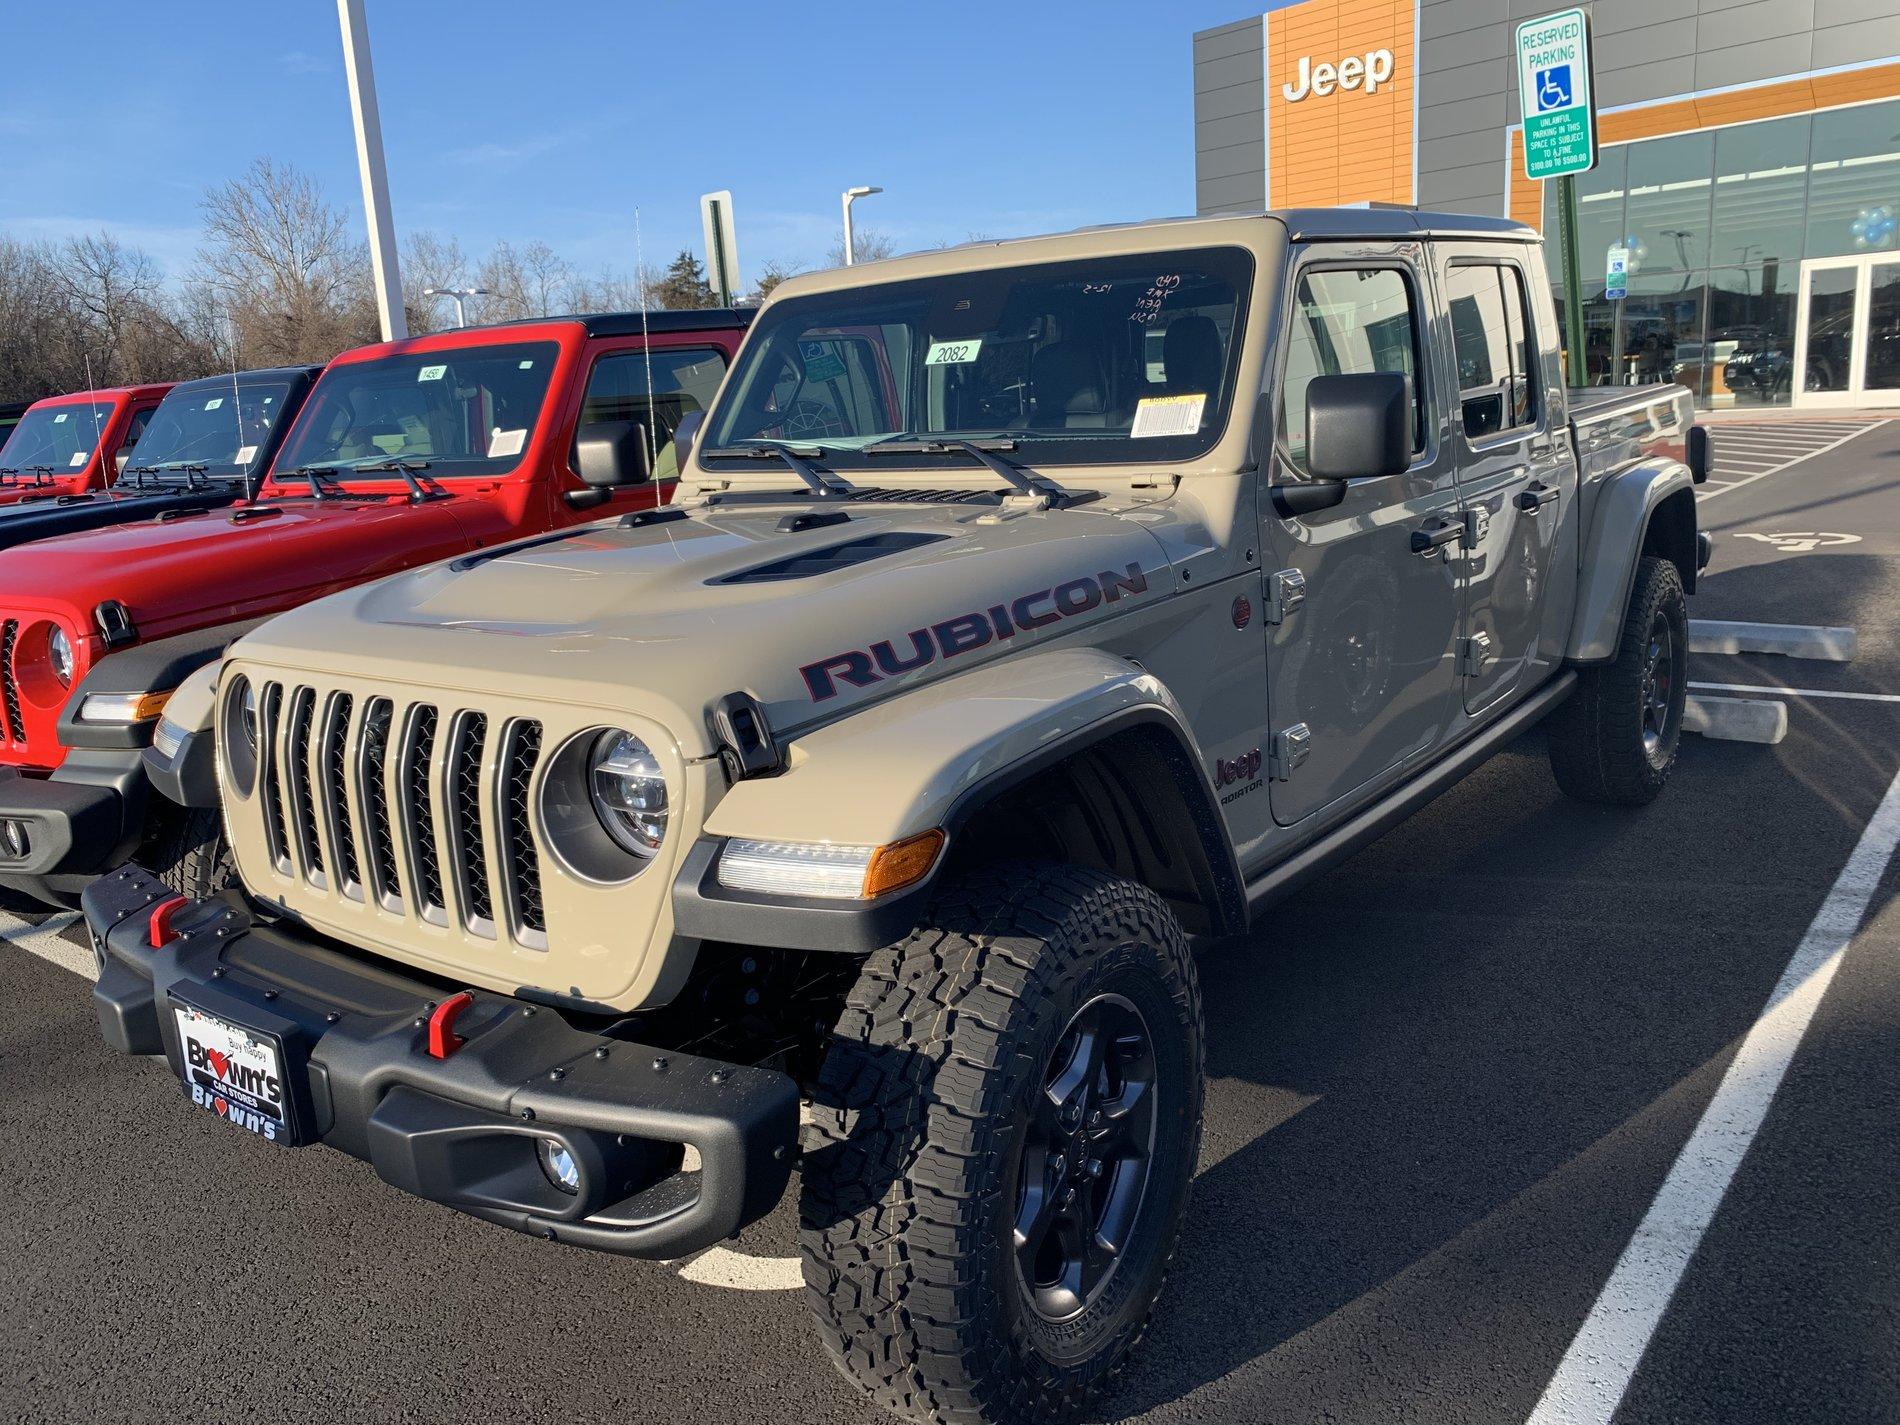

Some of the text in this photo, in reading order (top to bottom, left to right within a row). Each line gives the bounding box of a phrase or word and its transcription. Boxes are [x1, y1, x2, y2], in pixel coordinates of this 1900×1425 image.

[1522, 23, 1579, 50] RESERVED
[1529, 45, 1575, 69] PARKING
[1282, 48, 1395, 103] Jeep
[1532, 122, 1580, 139] PARKING IN THIS
[1540, 114, 1571, 127] UNLAWFUL
[1530, 132, 1584, 150] SPACE IS SUBJECT
[1544, 149, 1551, 158] TO
[1559, 145, 1572, 156] FINE
[935, 346, 968, 362] 2082
[799, 561, 1148, 703] RUBICON
[1214, 748, 1261, 791] Jeep
[1221, 779, 1263, 806] ADIATOR
[228, 1036, 267, 1063] Buy happy
[213, 1080, 259, 1108] CAR STORES
